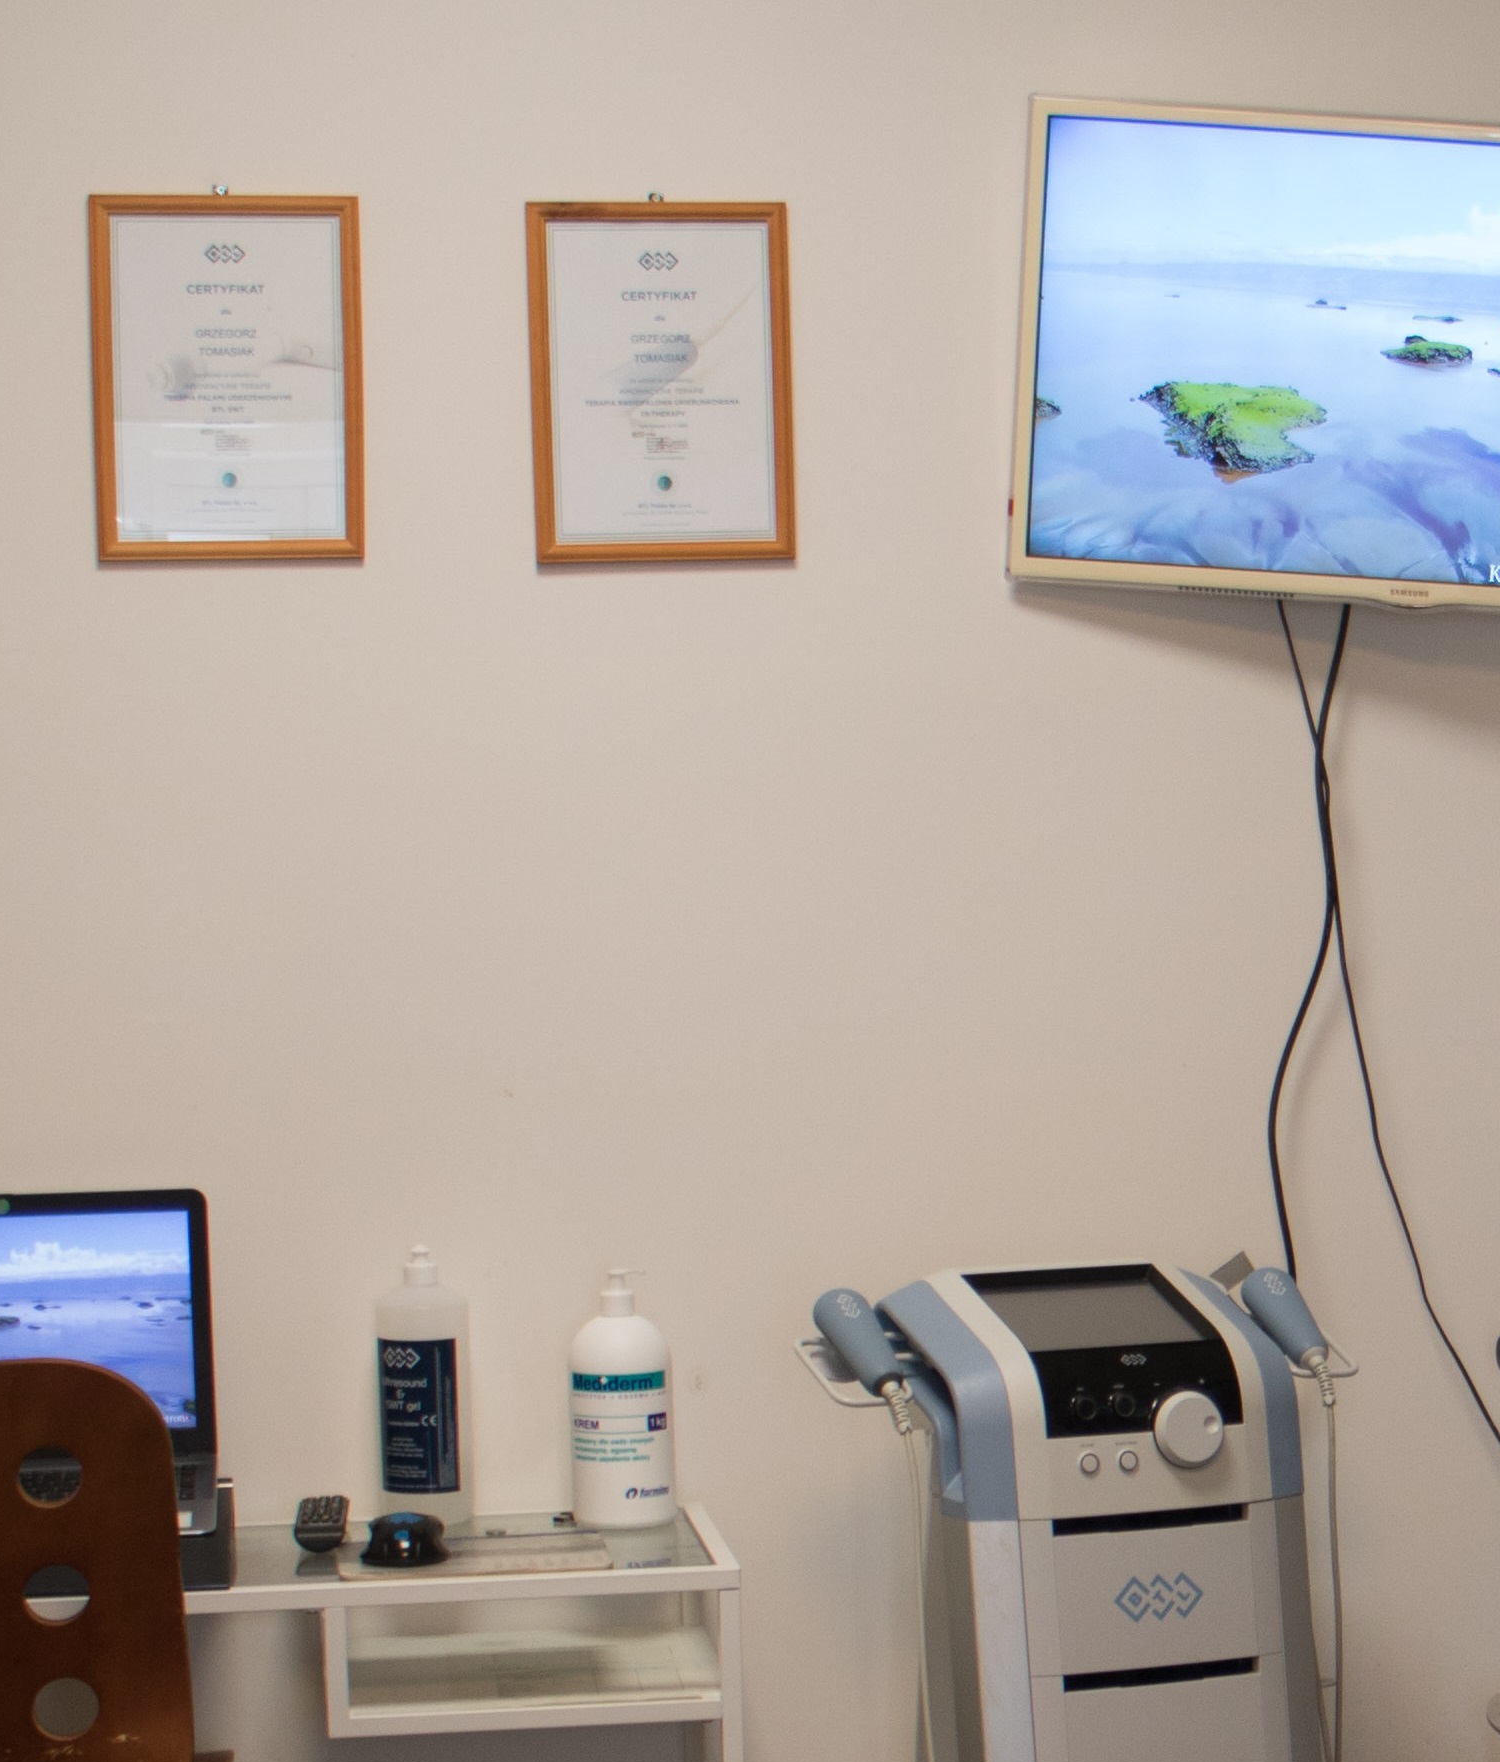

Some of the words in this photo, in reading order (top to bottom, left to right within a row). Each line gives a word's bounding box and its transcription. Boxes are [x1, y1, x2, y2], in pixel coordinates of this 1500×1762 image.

[186, 284, 266, 295] CERTYFIKAT
[621, 291, 697, 302] CERTYFIKAT
[195, 329, 257, 339] GRZEGORZ
[631, 335, 692, 344] GRZEGORZ
[199, 347, 255, 357] TOMASIAK
[634, 354, 689, 364] TOMASIAK
[1390, 589, 1429, 597] SAMSUNG
[573, 1375, 653, 1391] Mediderm
[574, 1418, 599, 1430] KREM
